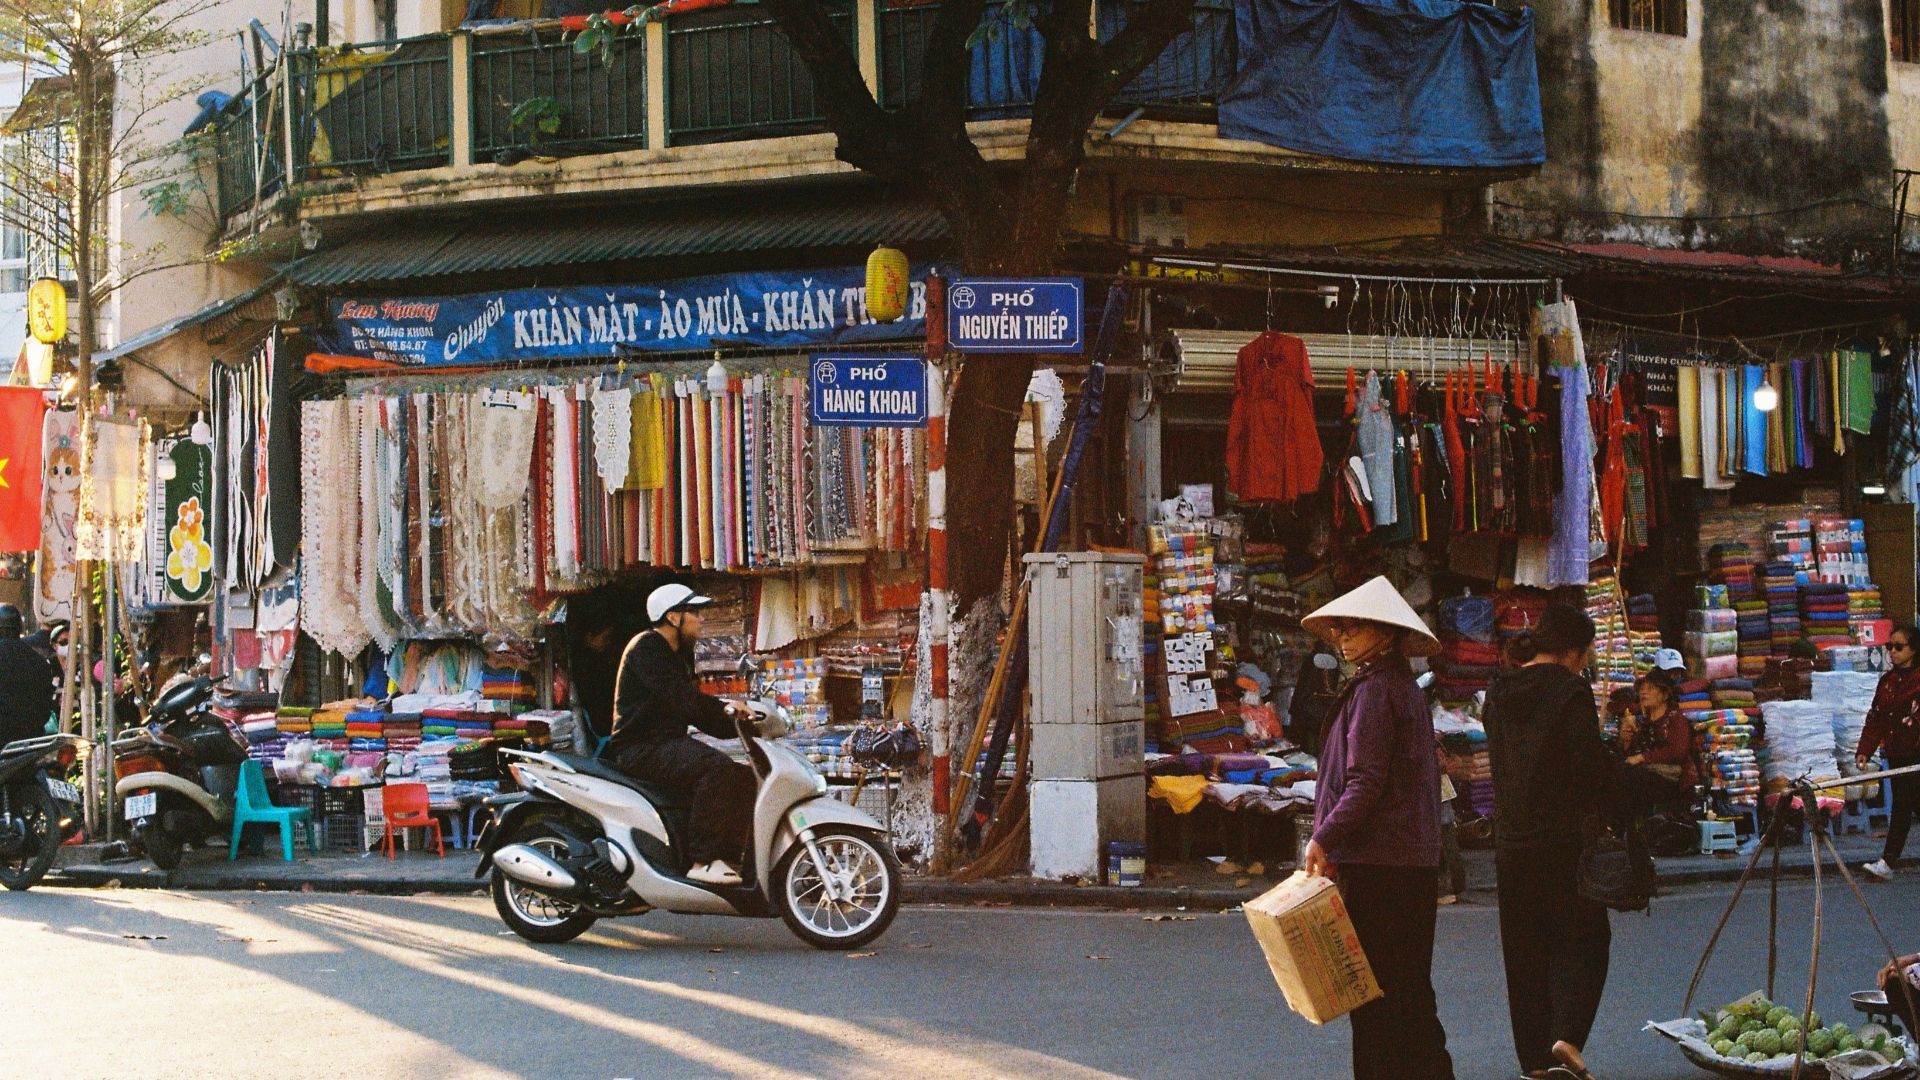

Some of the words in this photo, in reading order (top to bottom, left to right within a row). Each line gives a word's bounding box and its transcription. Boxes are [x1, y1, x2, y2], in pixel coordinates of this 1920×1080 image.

[514, 294, 582, 348] KHĂN
[696, 287, 749, 335] MƯA
[763, 277, 836, 332] KHĂN
[991, 287, 1036, 307] PHỐ
[378, 325, 404, 338] HÀNG
[407, 327, 434, 337] KHOAI
[443, 296, 506, 361] Chuyên
[959, 307, 1021, 340] NGUYỄN
[1025, 308, 1068, 340] THIẾP
[850, 362, 887, 381] PHỐ
[823, 384, 865, 413] HÀNG
[869, 389, 917, 415] KHOAI
